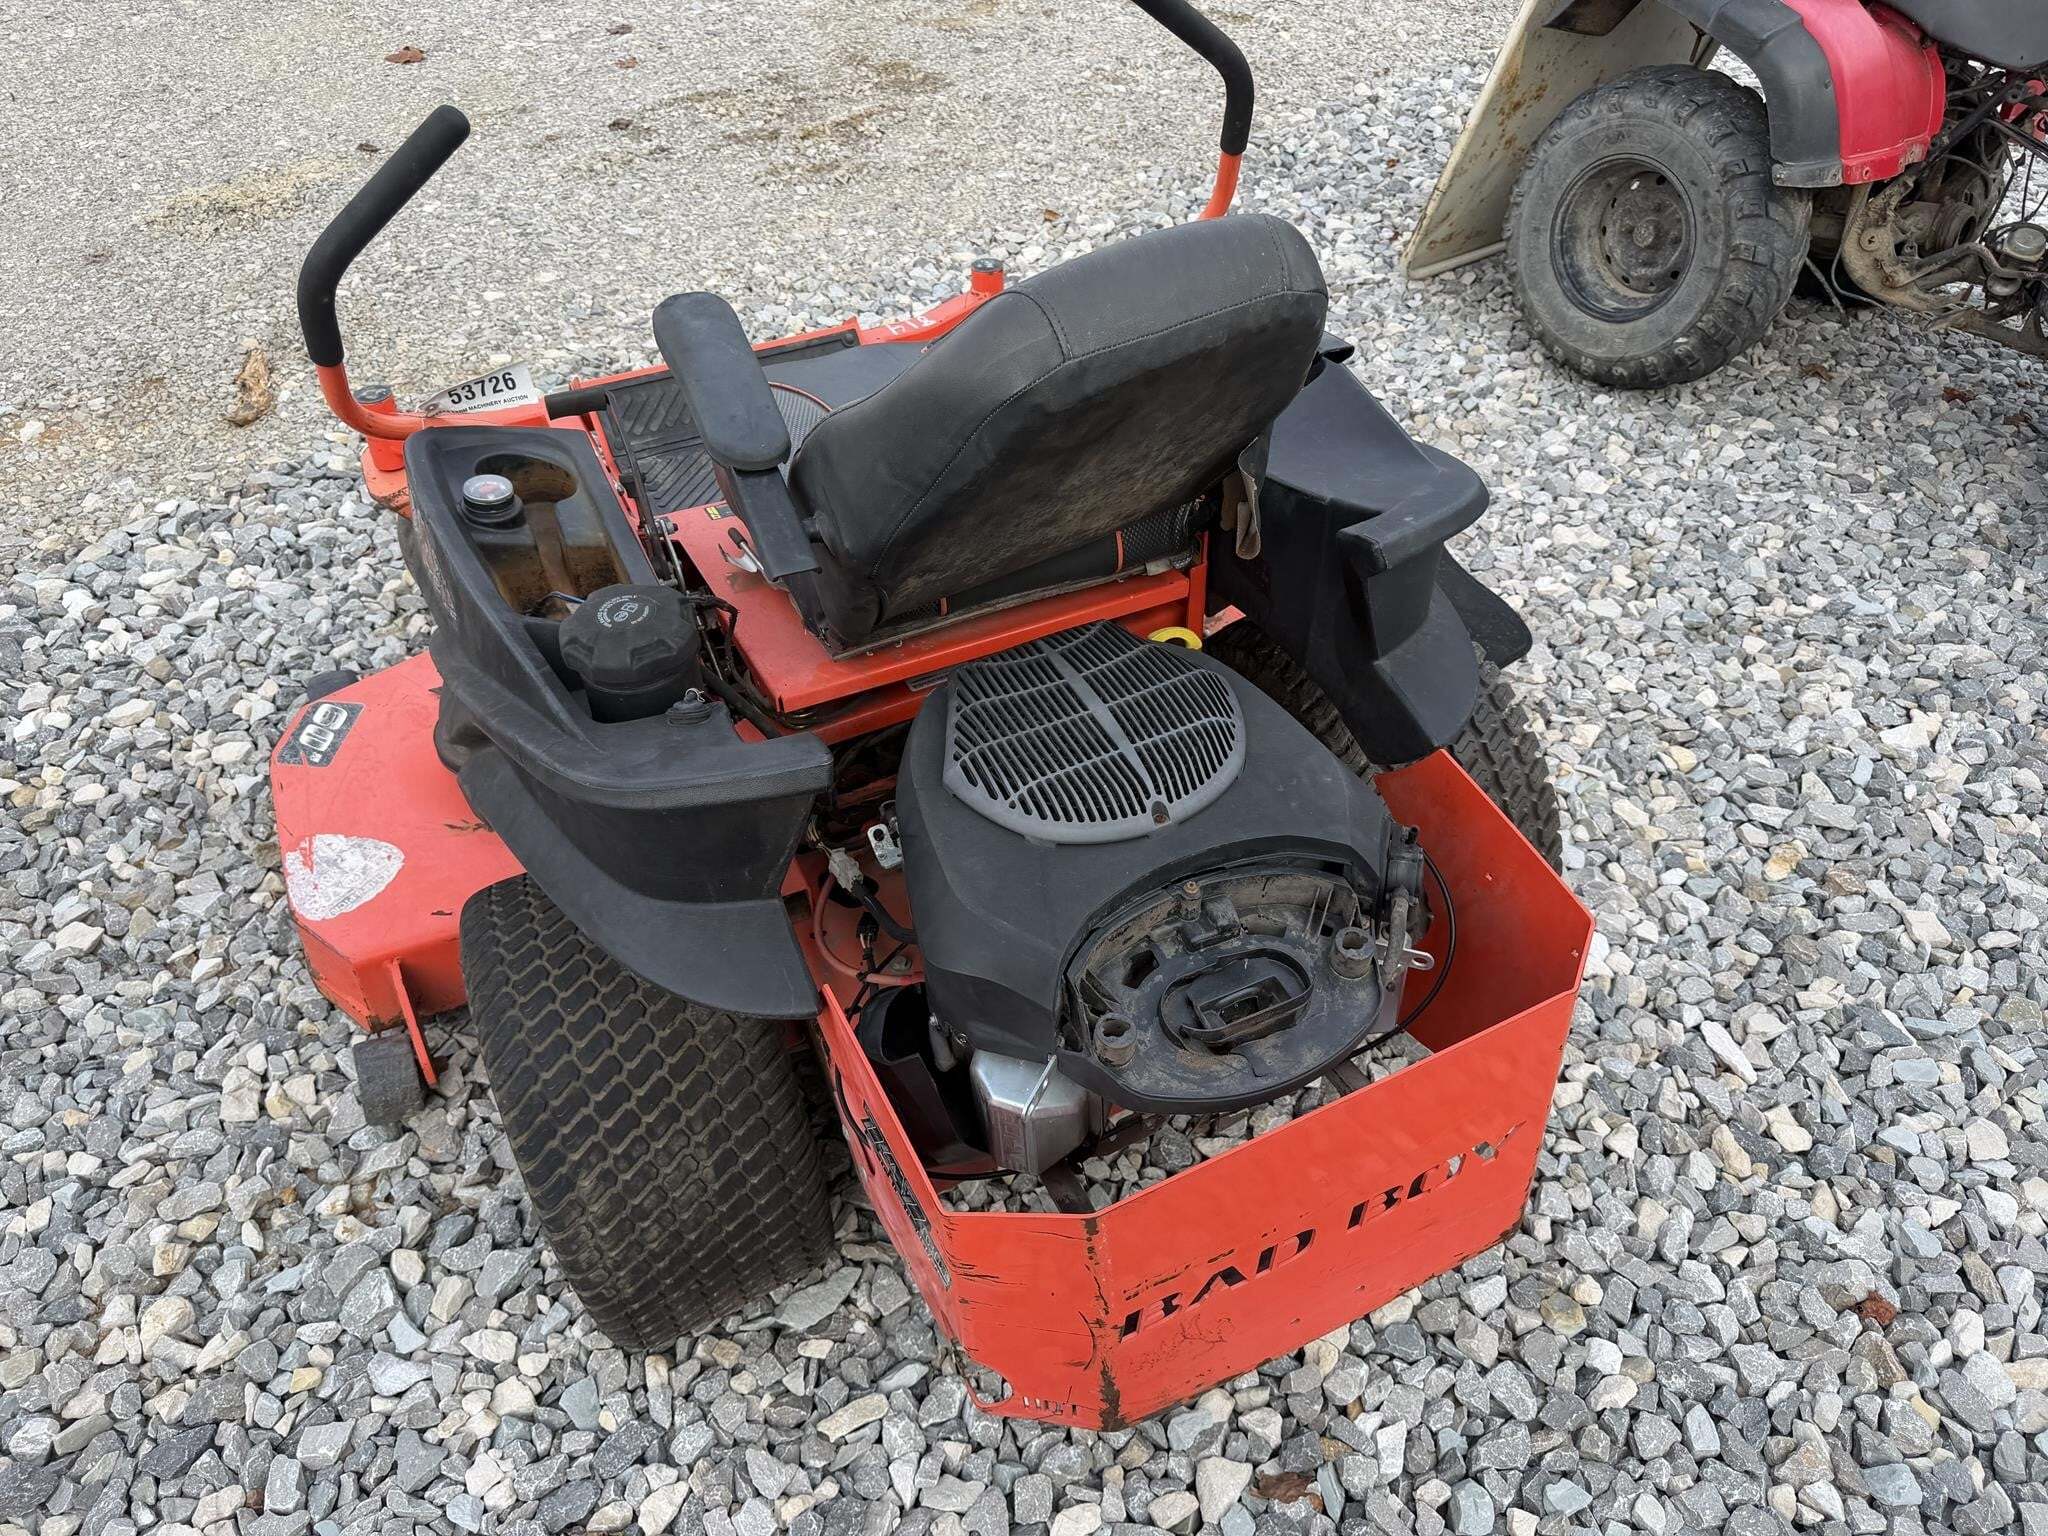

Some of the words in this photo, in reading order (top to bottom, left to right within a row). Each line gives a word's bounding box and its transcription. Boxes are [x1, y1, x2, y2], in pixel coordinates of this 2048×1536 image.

[447, 372, 517, 405] 53726
[468, 400, 502, 411] MACHINERY
[503, 394, 529, 404] AUCTION
[1119, 1228, 1316, 1343] BAD
[1345, 1119, 1527, 1231] BOY
